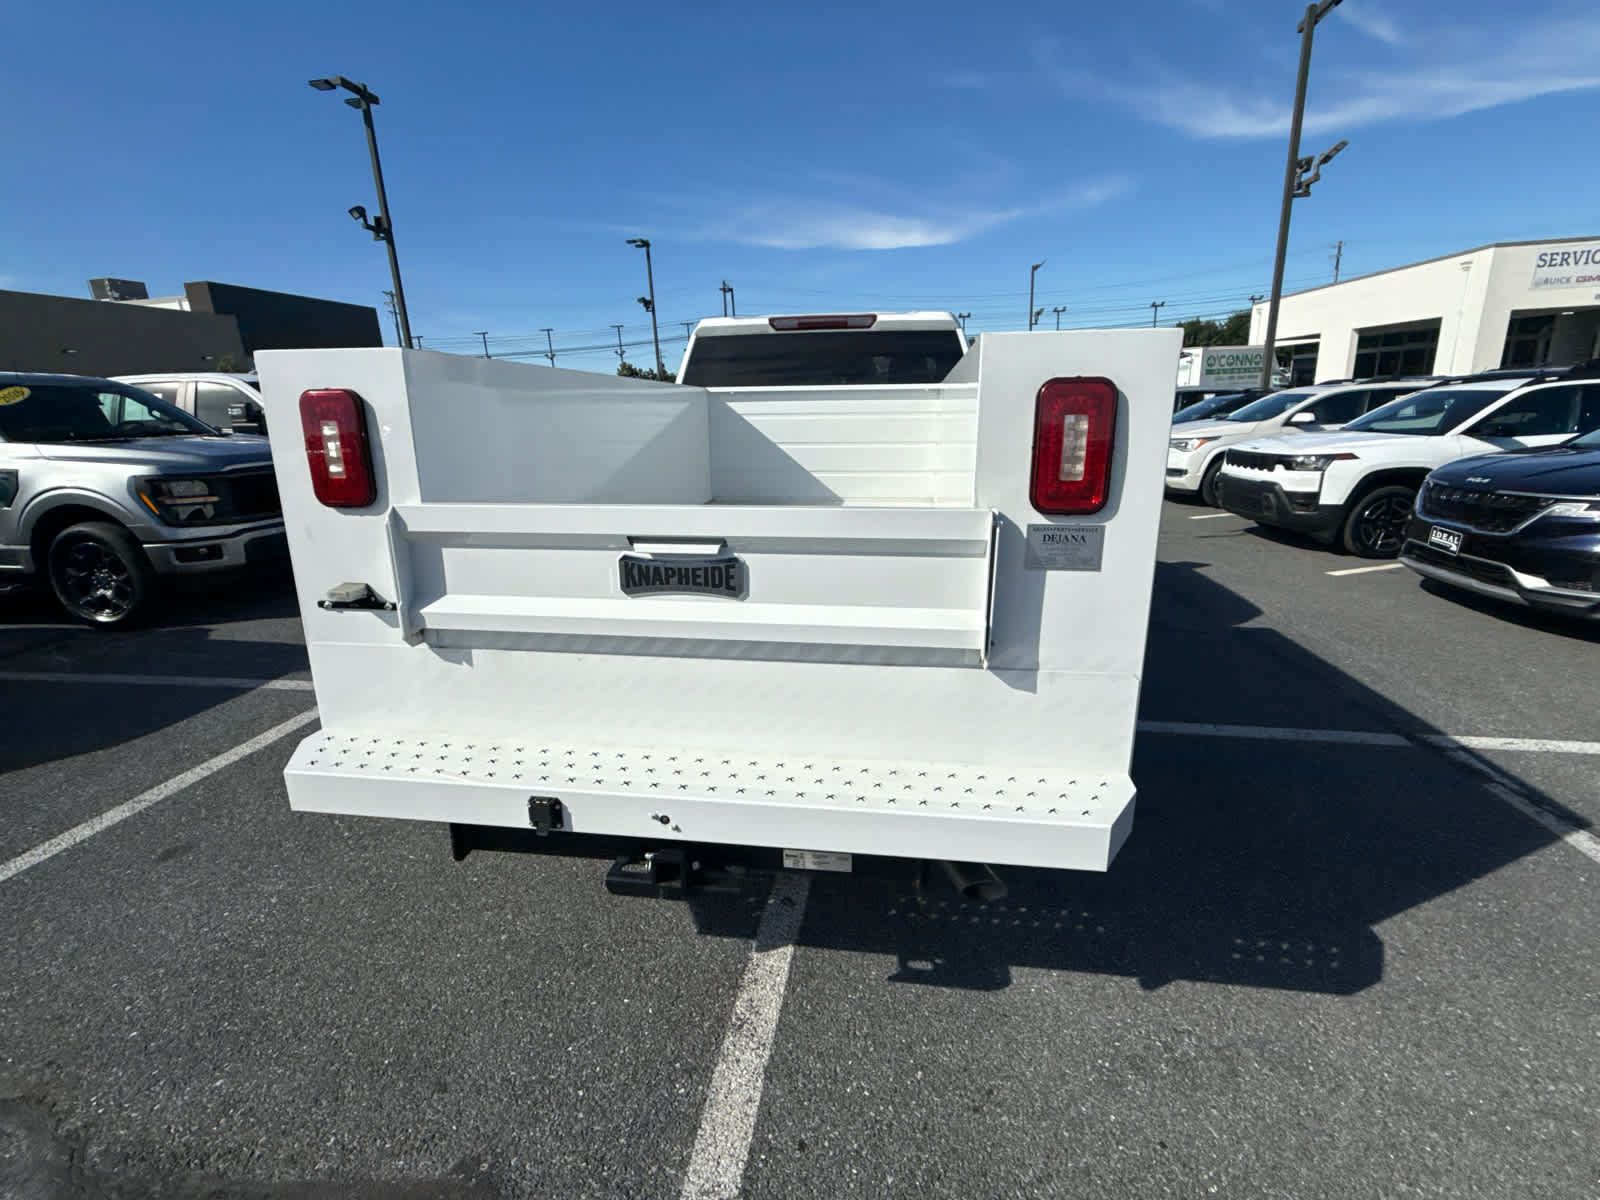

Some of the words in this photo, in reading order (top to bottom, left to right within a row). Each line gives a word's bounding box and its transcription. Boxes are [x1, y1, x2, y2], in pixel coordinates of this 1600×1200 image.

[1206, 352, 1266, 368] O'CONNO
[1041, 534, 1088, 544] DEJANA
[1432, 530, 1459, 544] IDEAL
[623, 560, 737, 592] KNAPHEIDE
